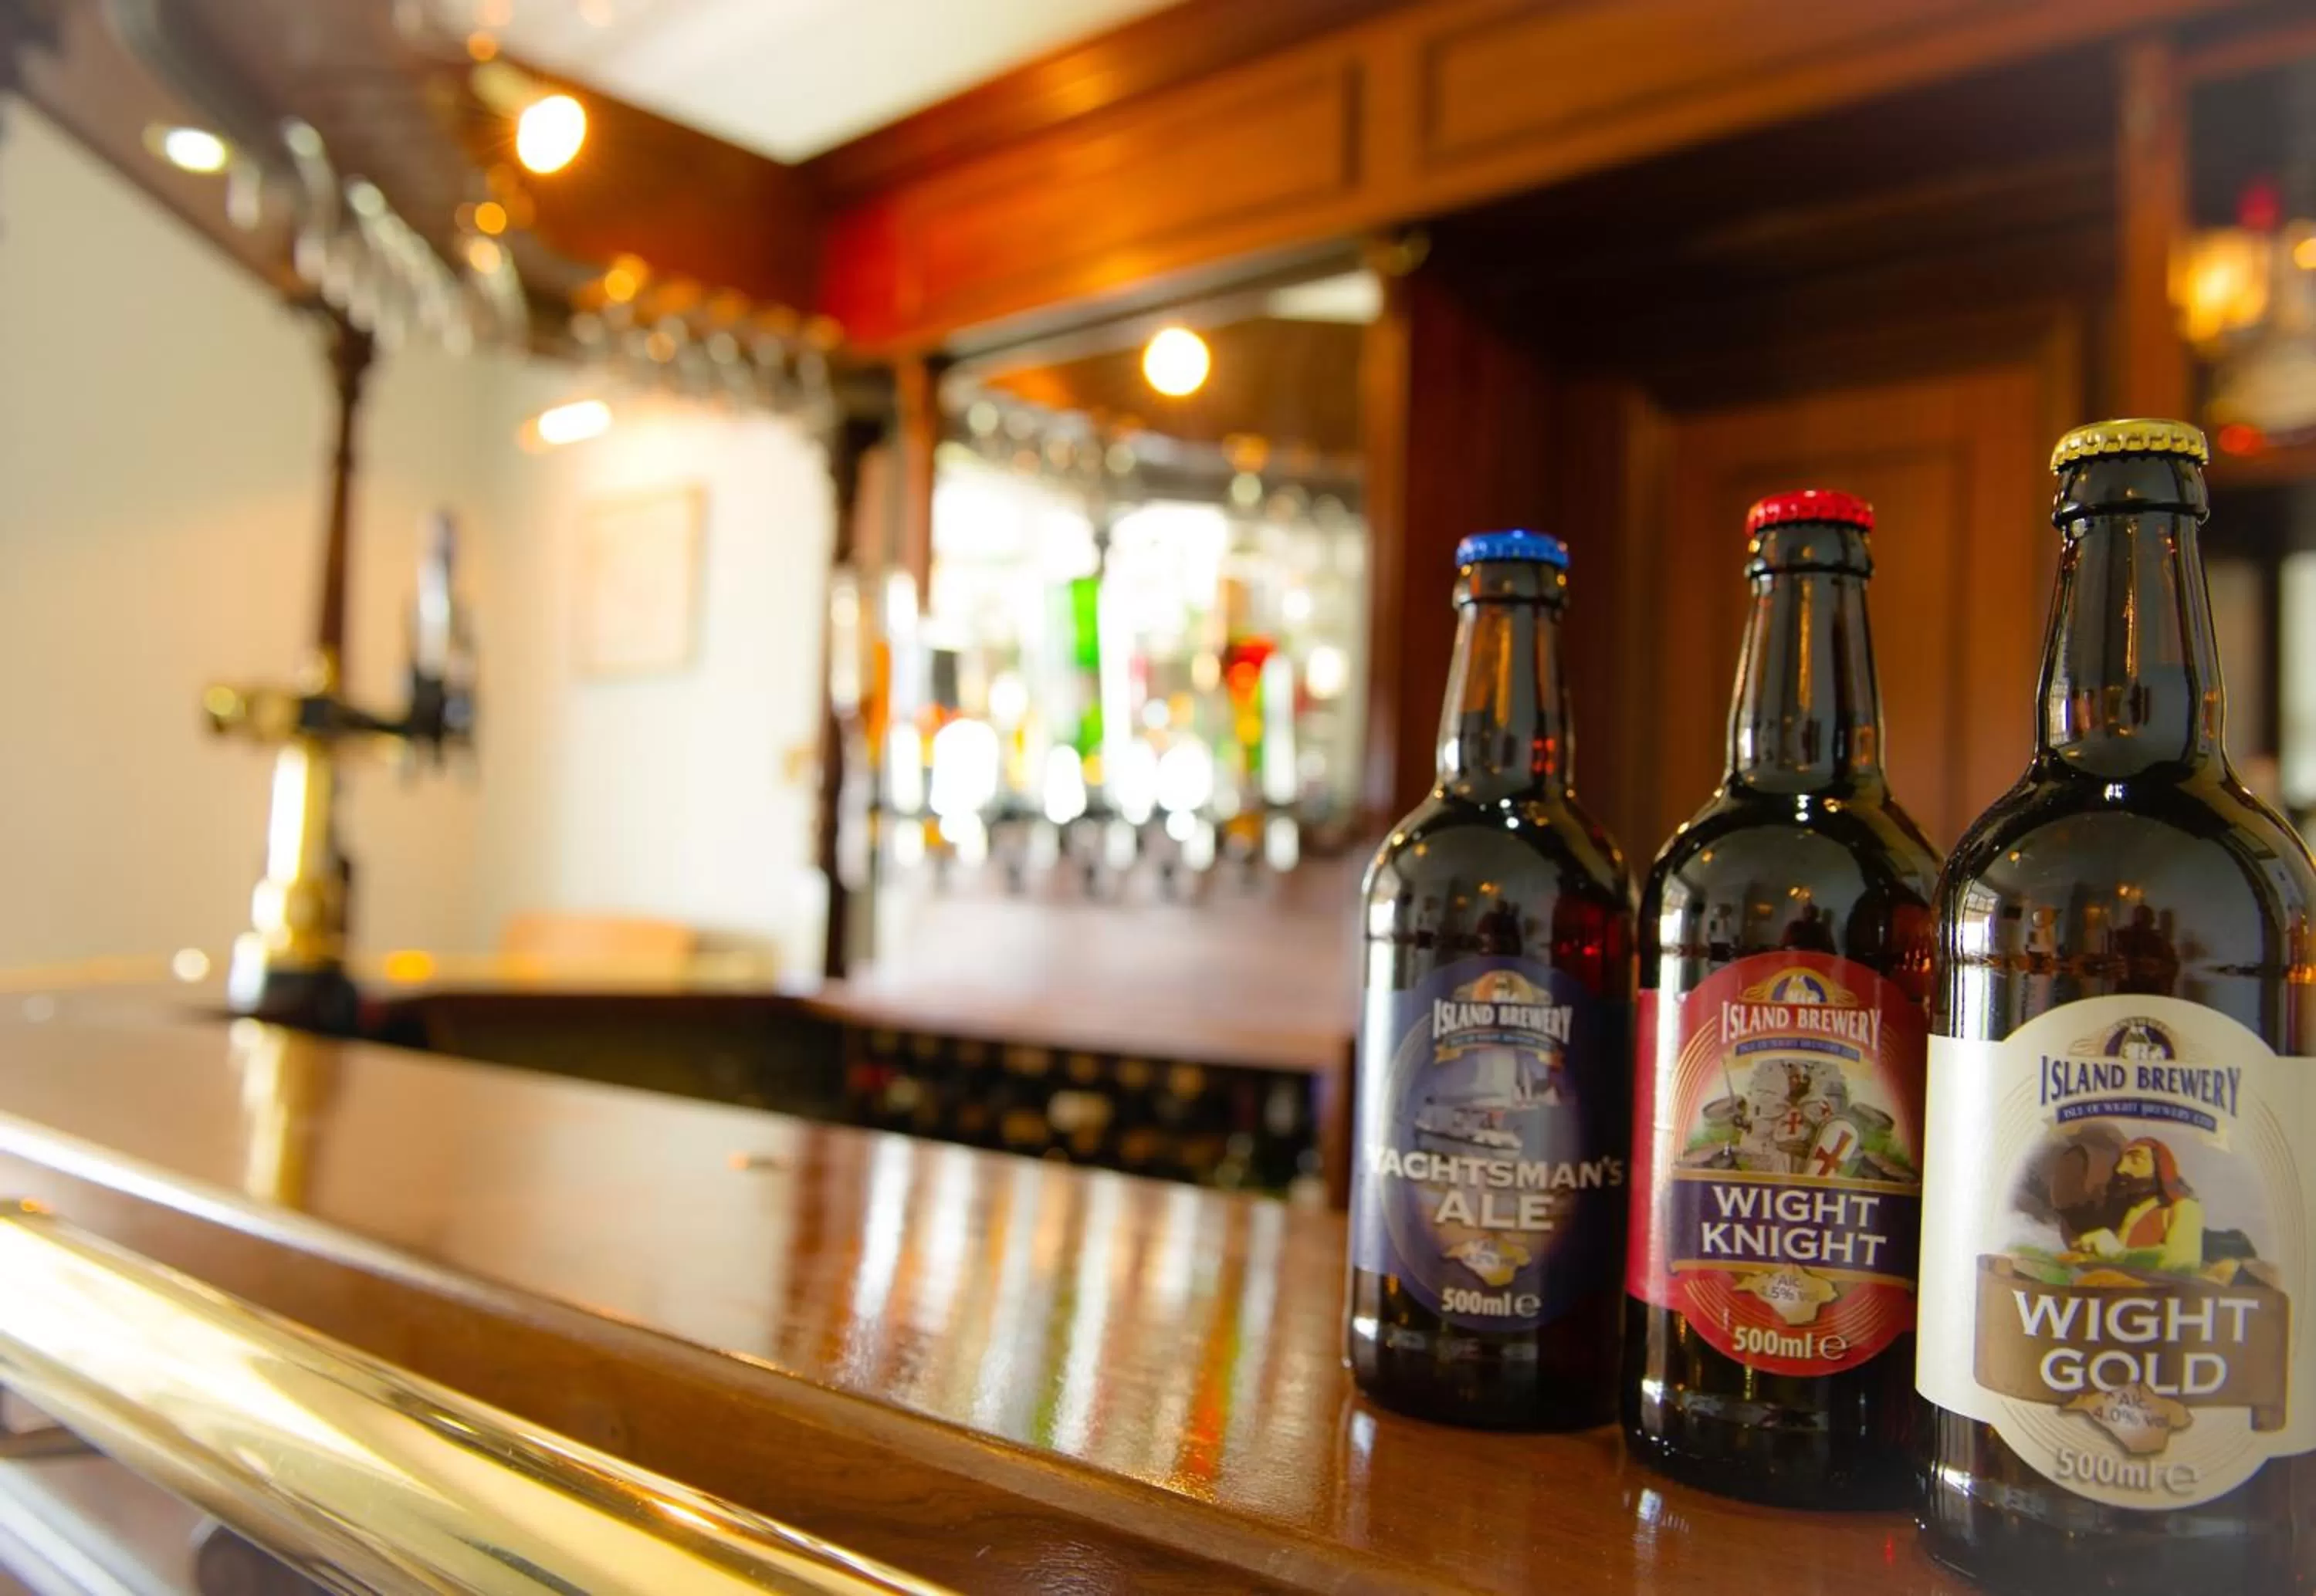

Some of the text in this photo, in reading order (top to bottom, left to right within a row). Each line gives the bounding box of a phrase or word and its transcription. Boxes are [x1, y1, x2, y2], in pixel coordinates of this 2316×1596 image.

[1433, 997, 1495, 1038] ISLAND
[1498, 1005, 1573, 1044] BREWERY
[1722, 1001, 1881, 1050] ISLAND BREWERY
[2040, 1055, 2241, 1117] ISLAND BREWERY
[1434, 1191, 1555, 1229] ALE
[1712, 1185, 1880, 1227] WIGHT
[1701, 1222, 1887, 1266] KNIGHT
[1441, 1287, 1512, 1317] 500ml
[2013, 1290, 2259, 1342] WIGHT
[1733, 1326, 1813, 1358] 500ml
[2040, 1347, 2227, 1395] GOLD
[2056, 1447, 2156, 1493] 500ml
